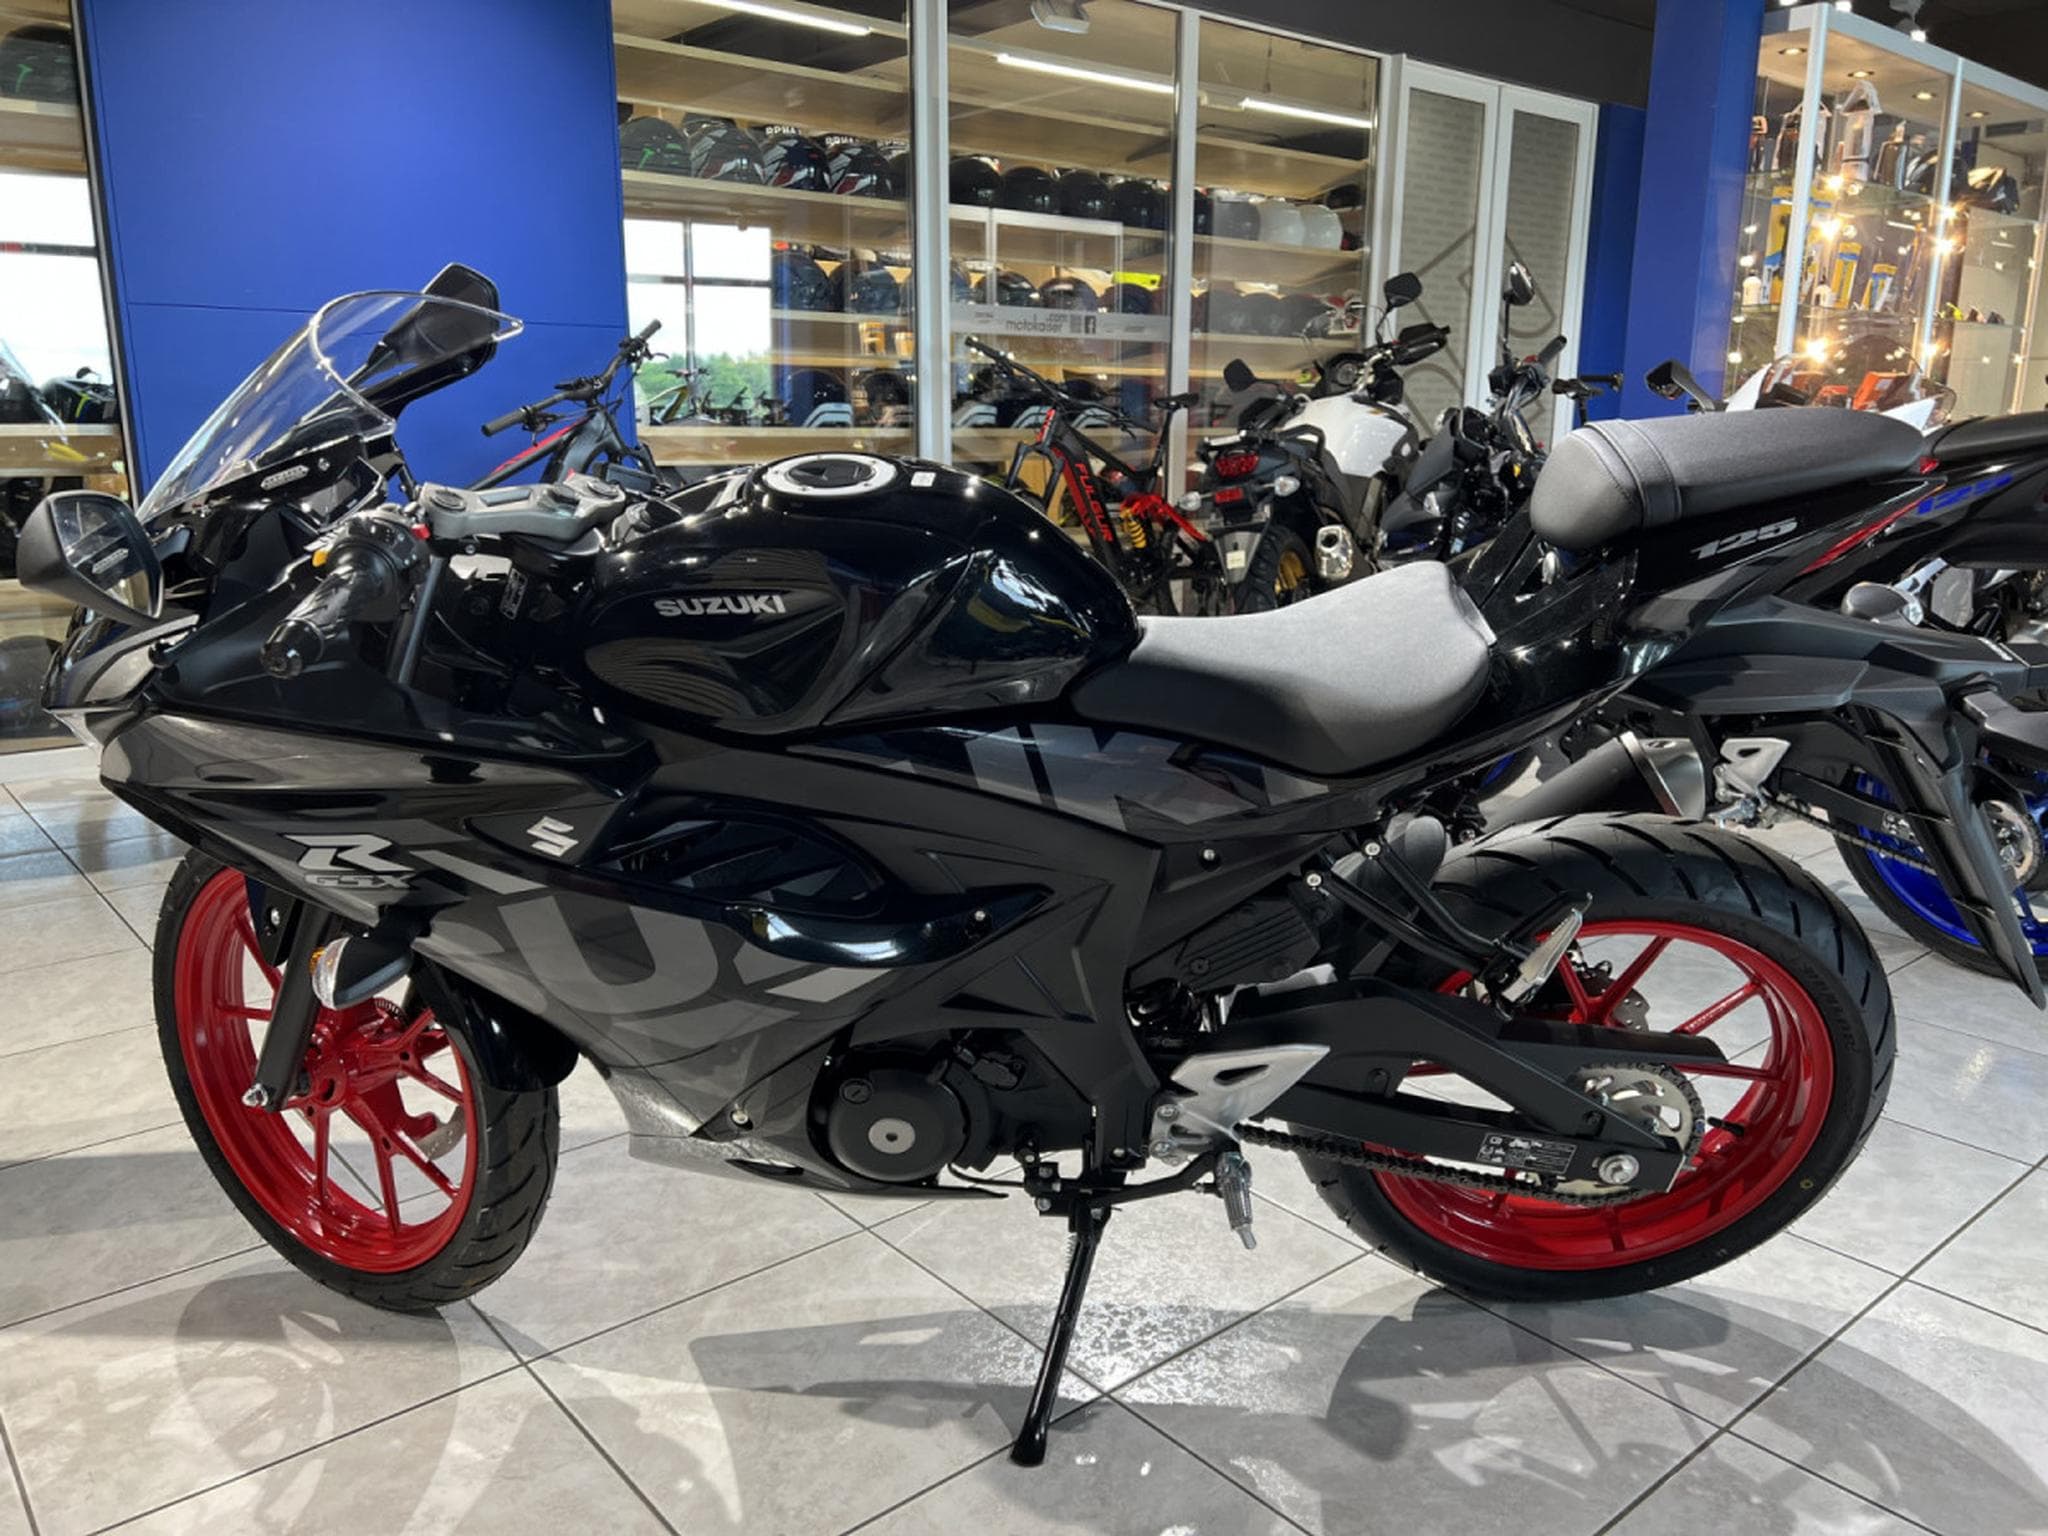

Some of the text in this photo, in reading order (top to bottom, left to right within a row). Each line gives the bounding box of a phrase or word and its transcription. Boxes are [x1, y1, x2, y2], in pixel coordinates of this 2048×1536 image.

[1690, 516, 1798, 560] 125
[653, 594, 787, 617] SUZUKI
[304, 873, 417, 889] GSX
